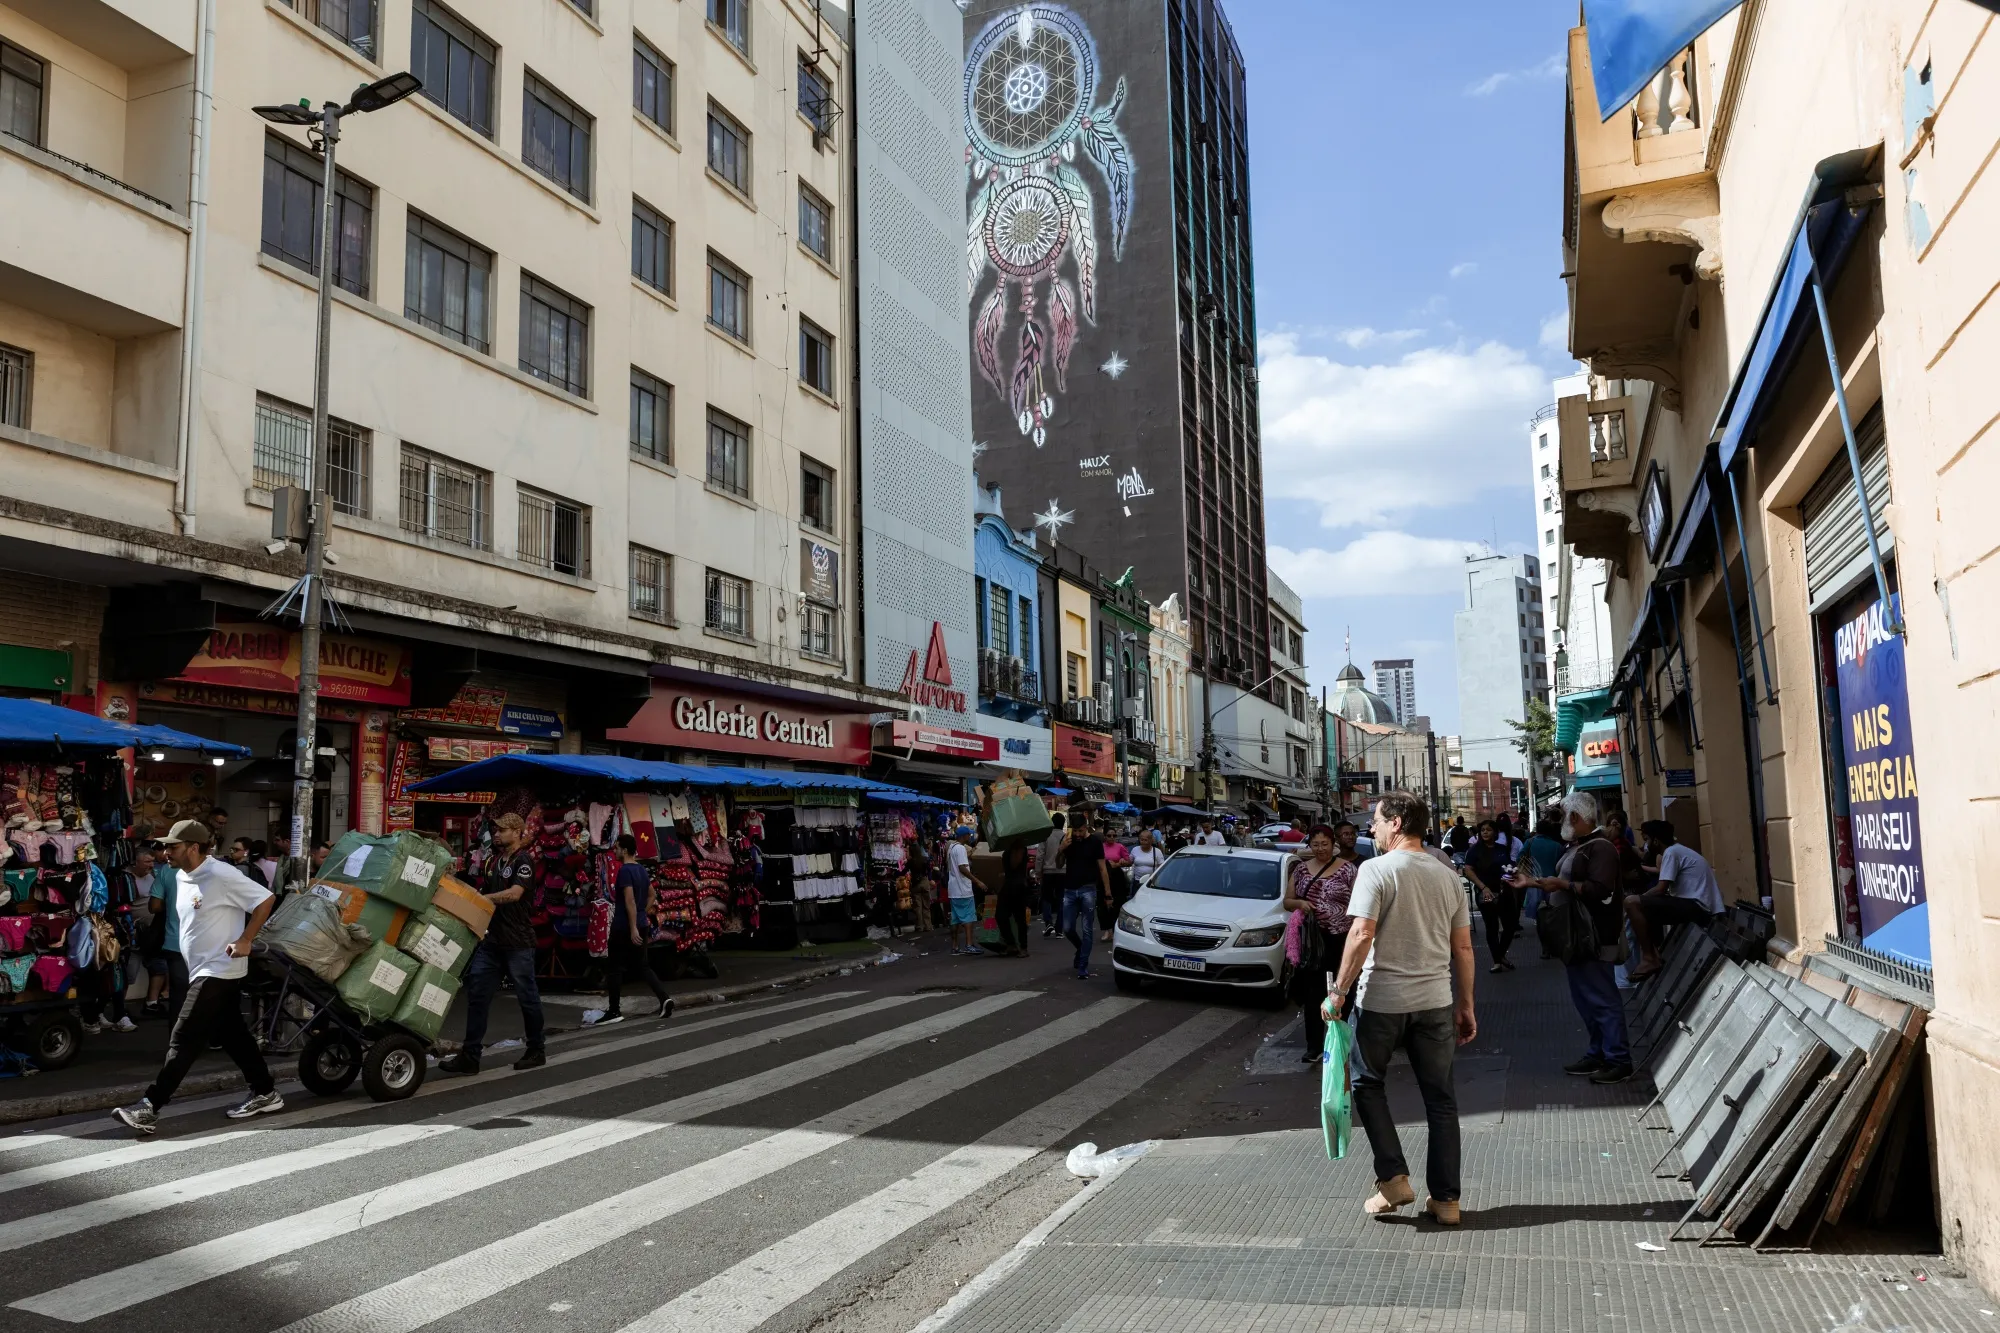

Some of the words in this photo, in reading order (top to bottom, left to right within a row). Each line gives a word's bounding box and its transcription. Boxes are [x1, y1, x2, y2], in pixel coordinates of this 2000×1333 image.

[1079, 455, 1110, 469] HAUX
[318, 641, 388, 677] ANCHE
[1837, 601, 1893, 668] RAYOVAC
[898, 650, 967, 713] Aurora
[507, 711, 521, 720] KIKI
[673, 696, 758, 740] Galeria
[763, 711, 834, 748] Central
[1852, 703, 1893, 752] MAIS
[390, 743, 405, 798] LANCHES
[1849, 755, 1918, 804] ENERGIA
[1856, 814, 1882, 850] PARA
[1881, 811, 1912, 851] SEU
